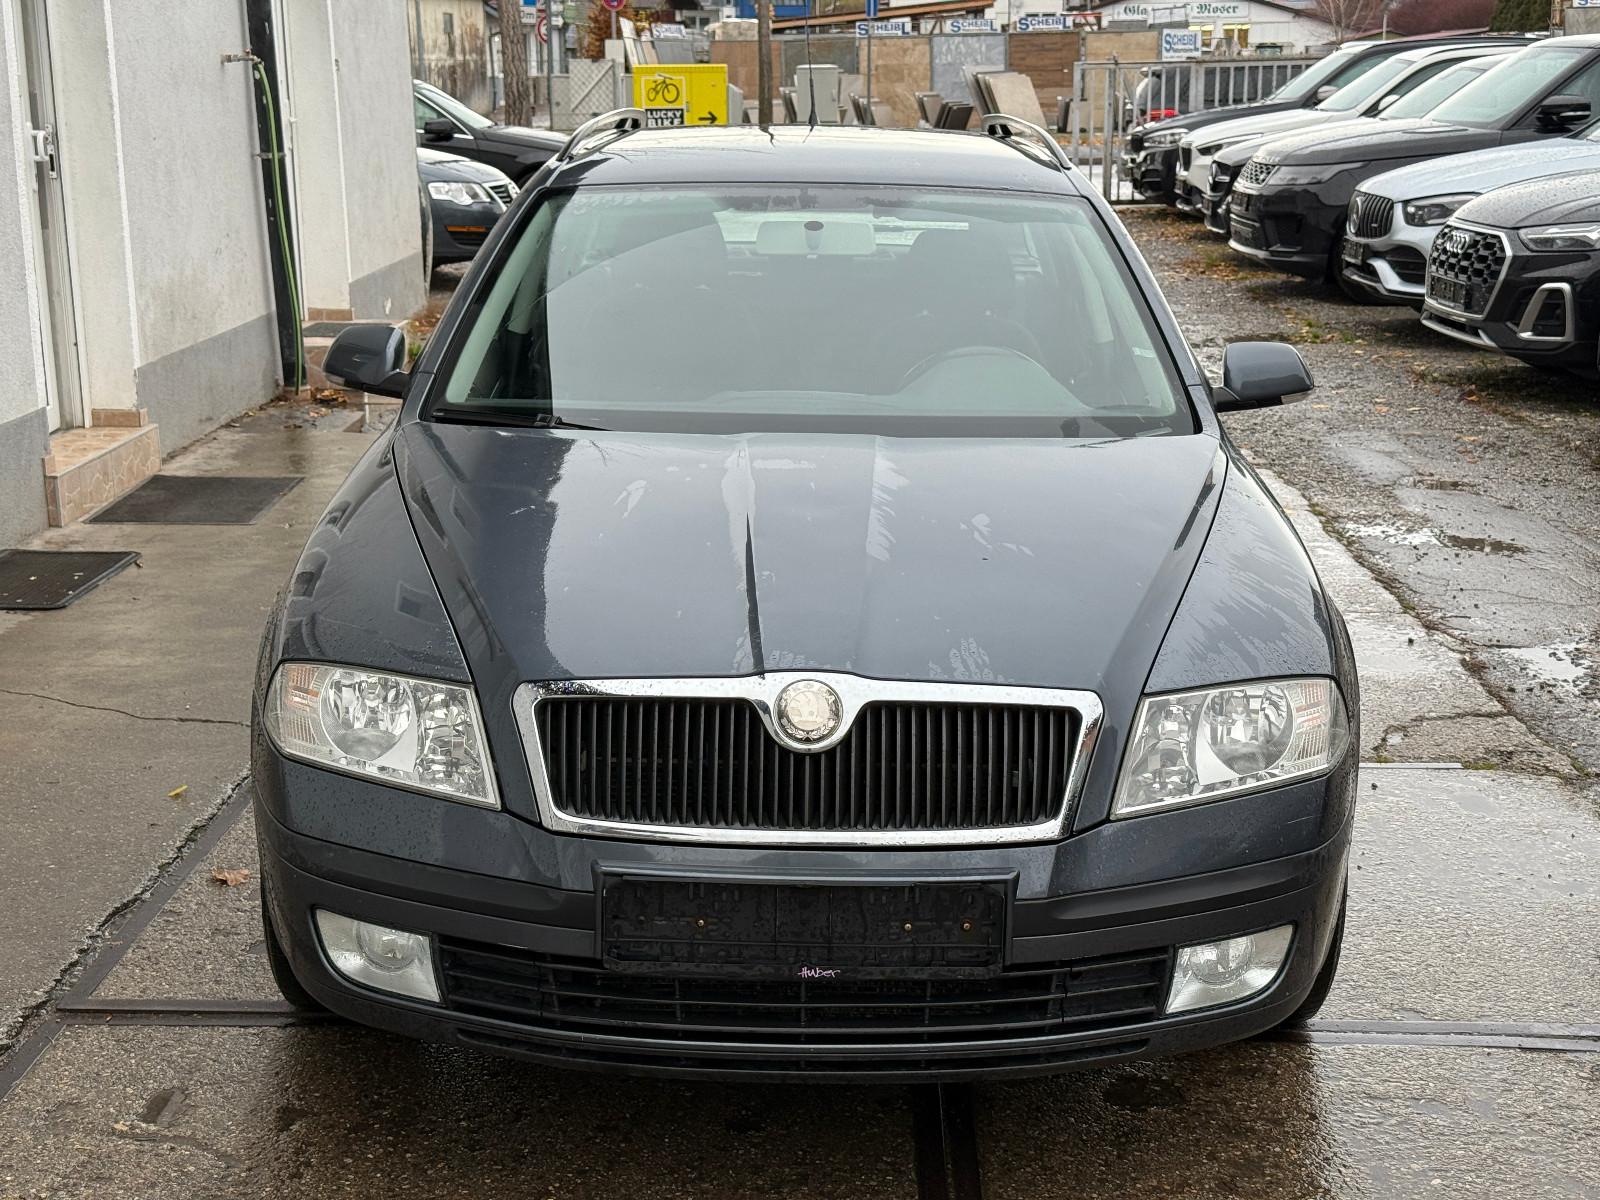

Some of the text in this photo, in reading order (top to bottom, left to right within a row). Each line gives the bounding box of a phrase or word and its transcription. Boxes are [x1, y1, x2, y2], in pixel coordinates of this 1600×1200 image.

[857, 22, 910, 36] SHEIBL
[951, 20, 998, 33] SCHEIBL
[1018, 16, 1071, 31] SCHEIBL
[1164, 33, 1199, 52] SCHEIBL
[647, 110, 682, 118] LUCKY
[647, 118, 682, 128] BIKE
[797, 966, 841, 979] Huber
